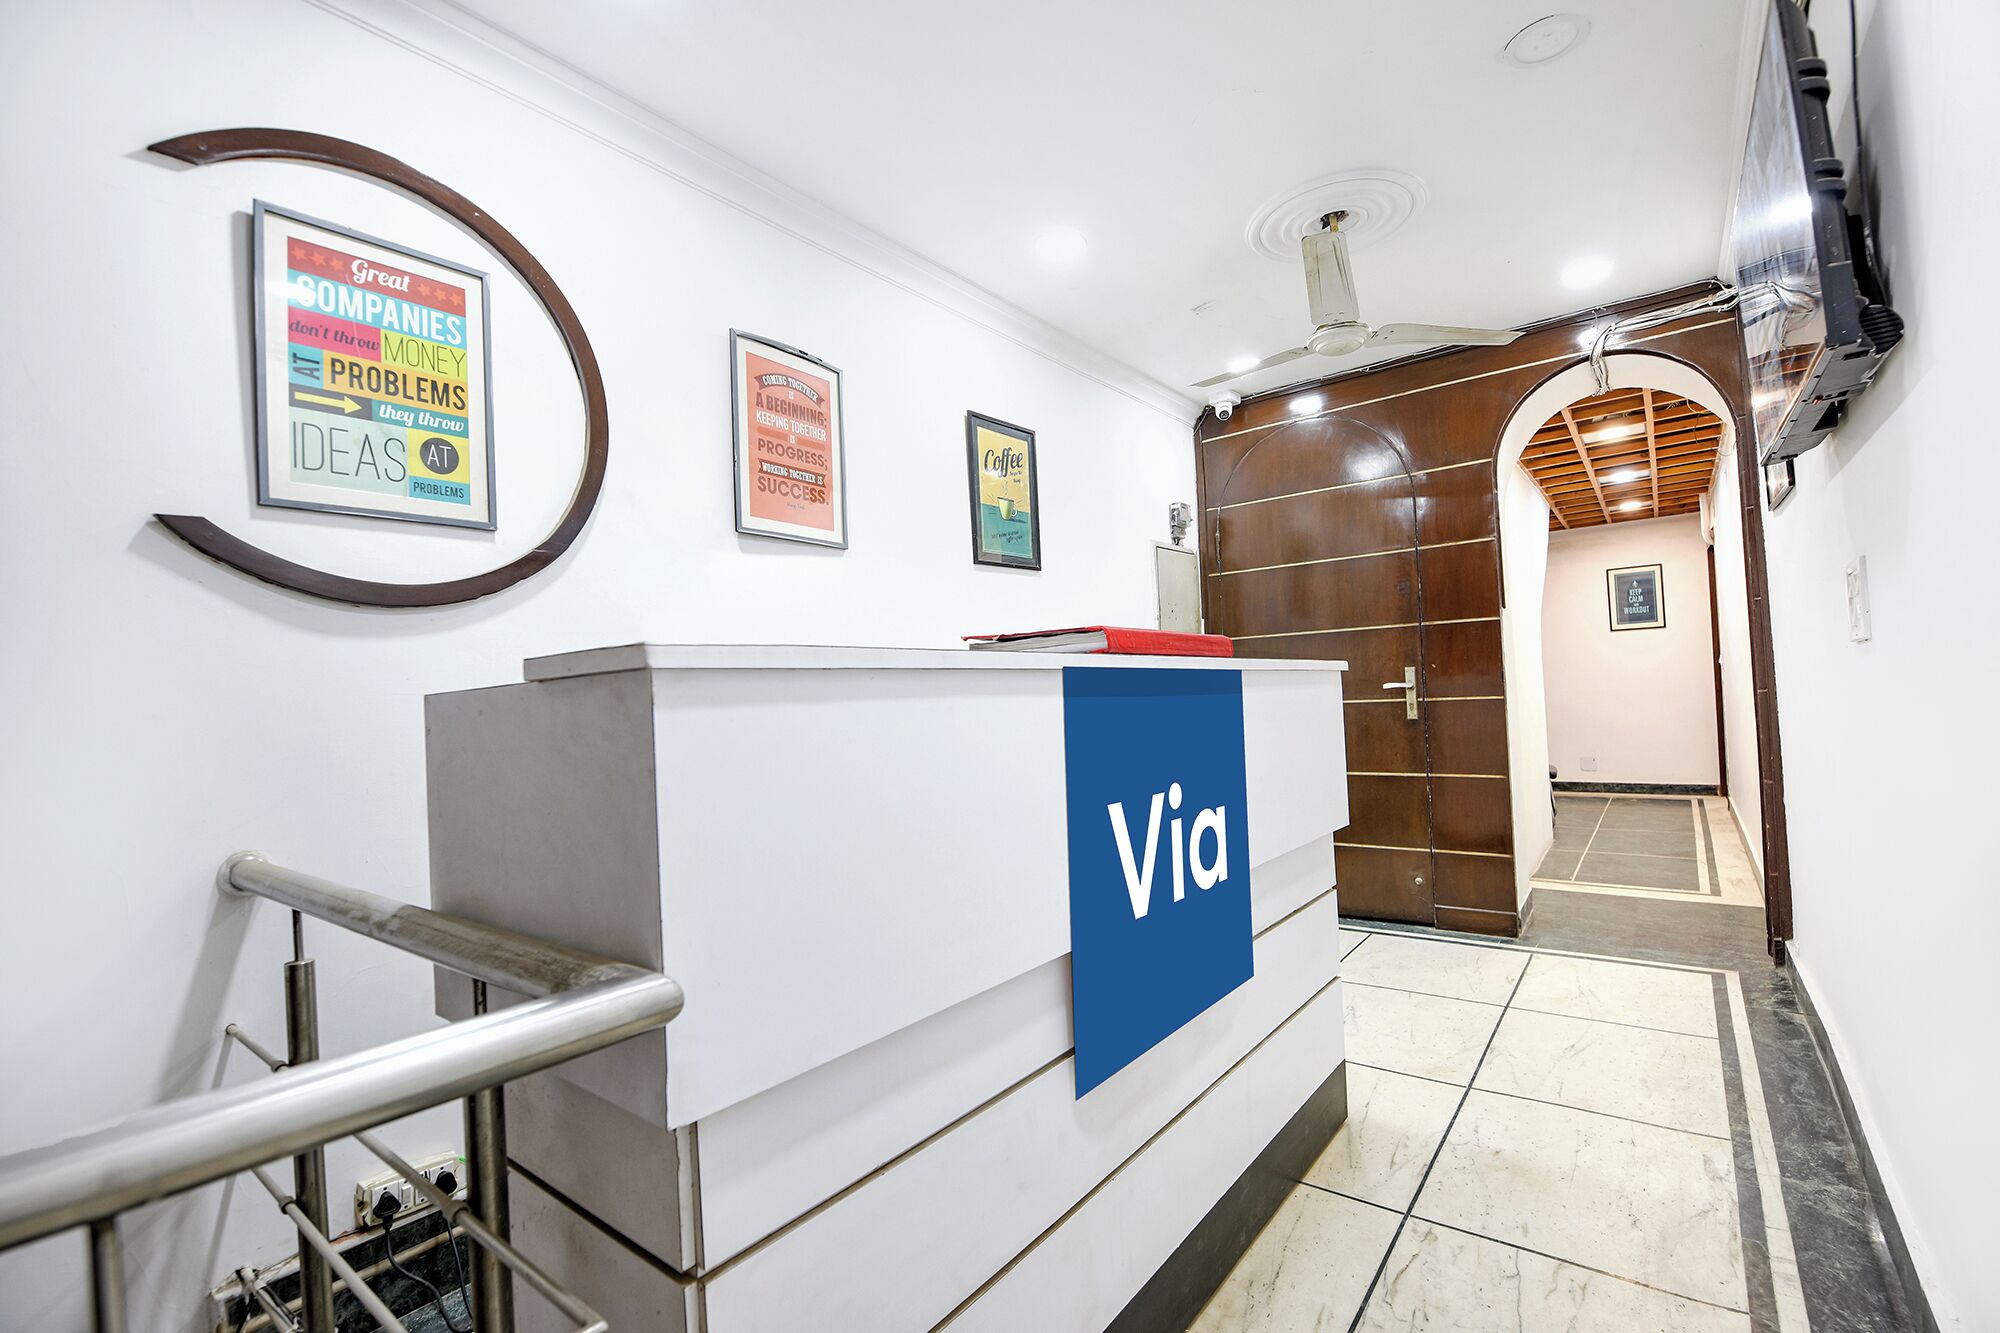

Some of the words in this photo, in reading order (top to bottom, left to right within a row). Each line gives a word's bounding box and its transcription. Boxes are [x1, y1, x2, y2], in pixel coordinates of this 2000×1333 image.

[351, 259, 411, 293] Great
[295, 275, 462, 345] COMPANIES
[288, 320, 330, 340] don't
[333, 324, 380, 351] throw
[384, 333, 466, 378] MONEY
[292, 352, 321, 381] AT
[330, 357, 467, 411] PROBLEMS
[762, 374, 787, 386] COMING
[787, 377, 819, 402] TOGETHER
[756, 392, 764, 408] A
[379, 404, 414, 427] they
[418, 410, 465, 432] throw
[756, 409, 789, 431] KEEPING
[789, 419, 827, 442] TOGETHER
[292, 421, 407, 483] IDEAS
[426, 444, 452, 468] AT
[984, 447, 1024, 478] Coffee
[761, 461, 788, 477] WORKING
[788, 468, 816, 484] TOGETHER
[413, 481, 465, 499] PROBLEMS
[1624, 606, 1649, 614] WORKOUT
[1629, 595, 1643, 603] CALM
[1107, 782, 1228, 920] Via
